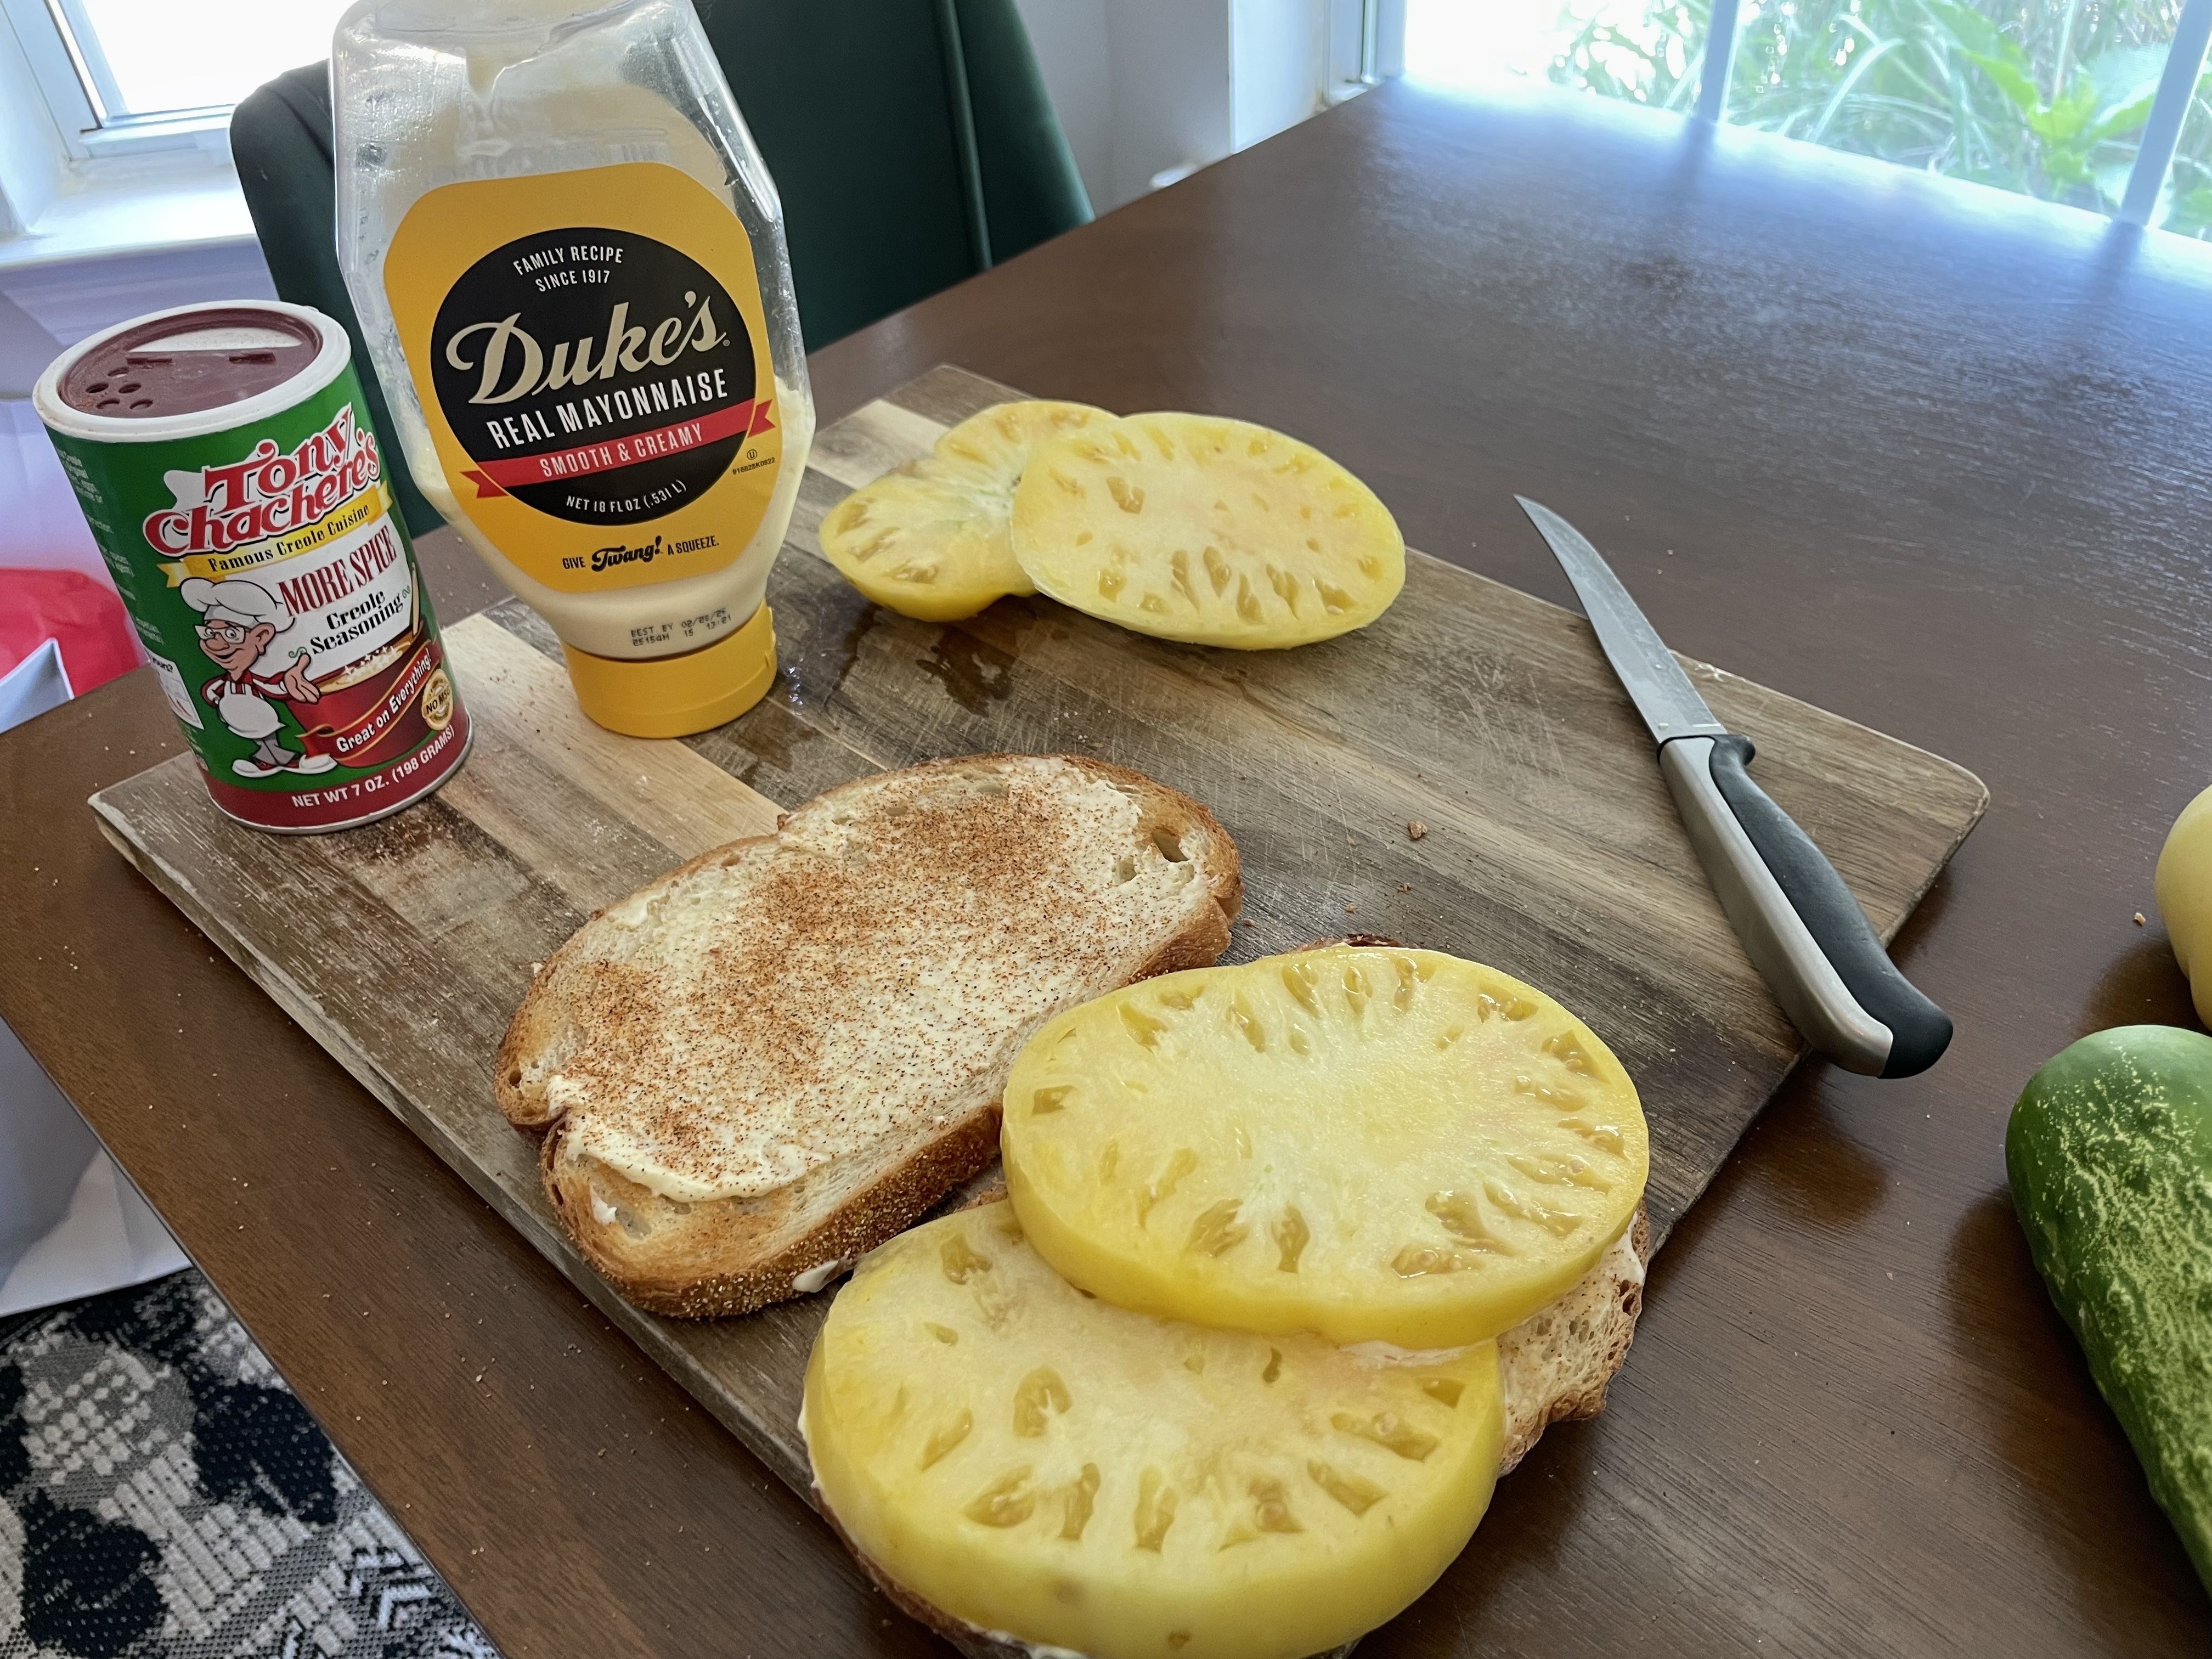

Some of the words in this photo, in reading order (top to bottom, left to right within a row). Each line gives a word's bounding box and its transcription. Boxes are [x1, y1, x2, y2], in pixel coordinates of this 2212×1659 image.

[513, 247, 564, 275] FAMILY
[570, 246, 623, 263] RECIPE
[535, 270, 577, 292] SINCE
[583, 269, 610, 284] 1917
[446, 291, 727, 404] Duke's
[486, 410, 555, 450] REAL
[556, 368, 729, 433] MAYONNAISE
[204, 405, 353, 514] Tony
[539, 447, 613, 477] SMOOTH
[618, 443, 631, 461] &
[635, 423, 703, 458] CREAMY
[144, 429, 380, 555] Chachere's
[566, 495, 590, 511] NET
[594, 500, 606, 512] 18
[644, 487, 673, 509] (.531
[672, 479, 687, 494] L)
[208, 549, 274, 572] Famous
[276, 528, 325, 555] Creole
[328, 504, 370, 536] Cuisine
[562, 556, 586, 569] GIVE
[591, 535, 663, 573] Twang!
[668, 544, 674, 556] A
[675, 535, 720, 554] SQUEEZE.
[276, 558, 355, 618] MORE
[349, 524, 397, 588] SPICE
[310, 594, 404, 655] Seasoning
[326, 590, 386, 630] Creole
[631, 626, 654, 637] BEST
[662, 623, 673, 632] BY
[336, 723, 376, 753] Great
[376, 709, 390, 728] on
[388, 647, 432, 714] Everything!
[426, 699, 438, 715] NO
[438, 684, 450, 705] MSG
[291, 793, 320, 808] NET
[323, 787, 348, 803] WT
[351, 783, 360, 796] 7
[364, 775, 389, 793] OZ.
[392, 757, 419, 783] (198
[419, 724, 455, 764] GRAMS)
